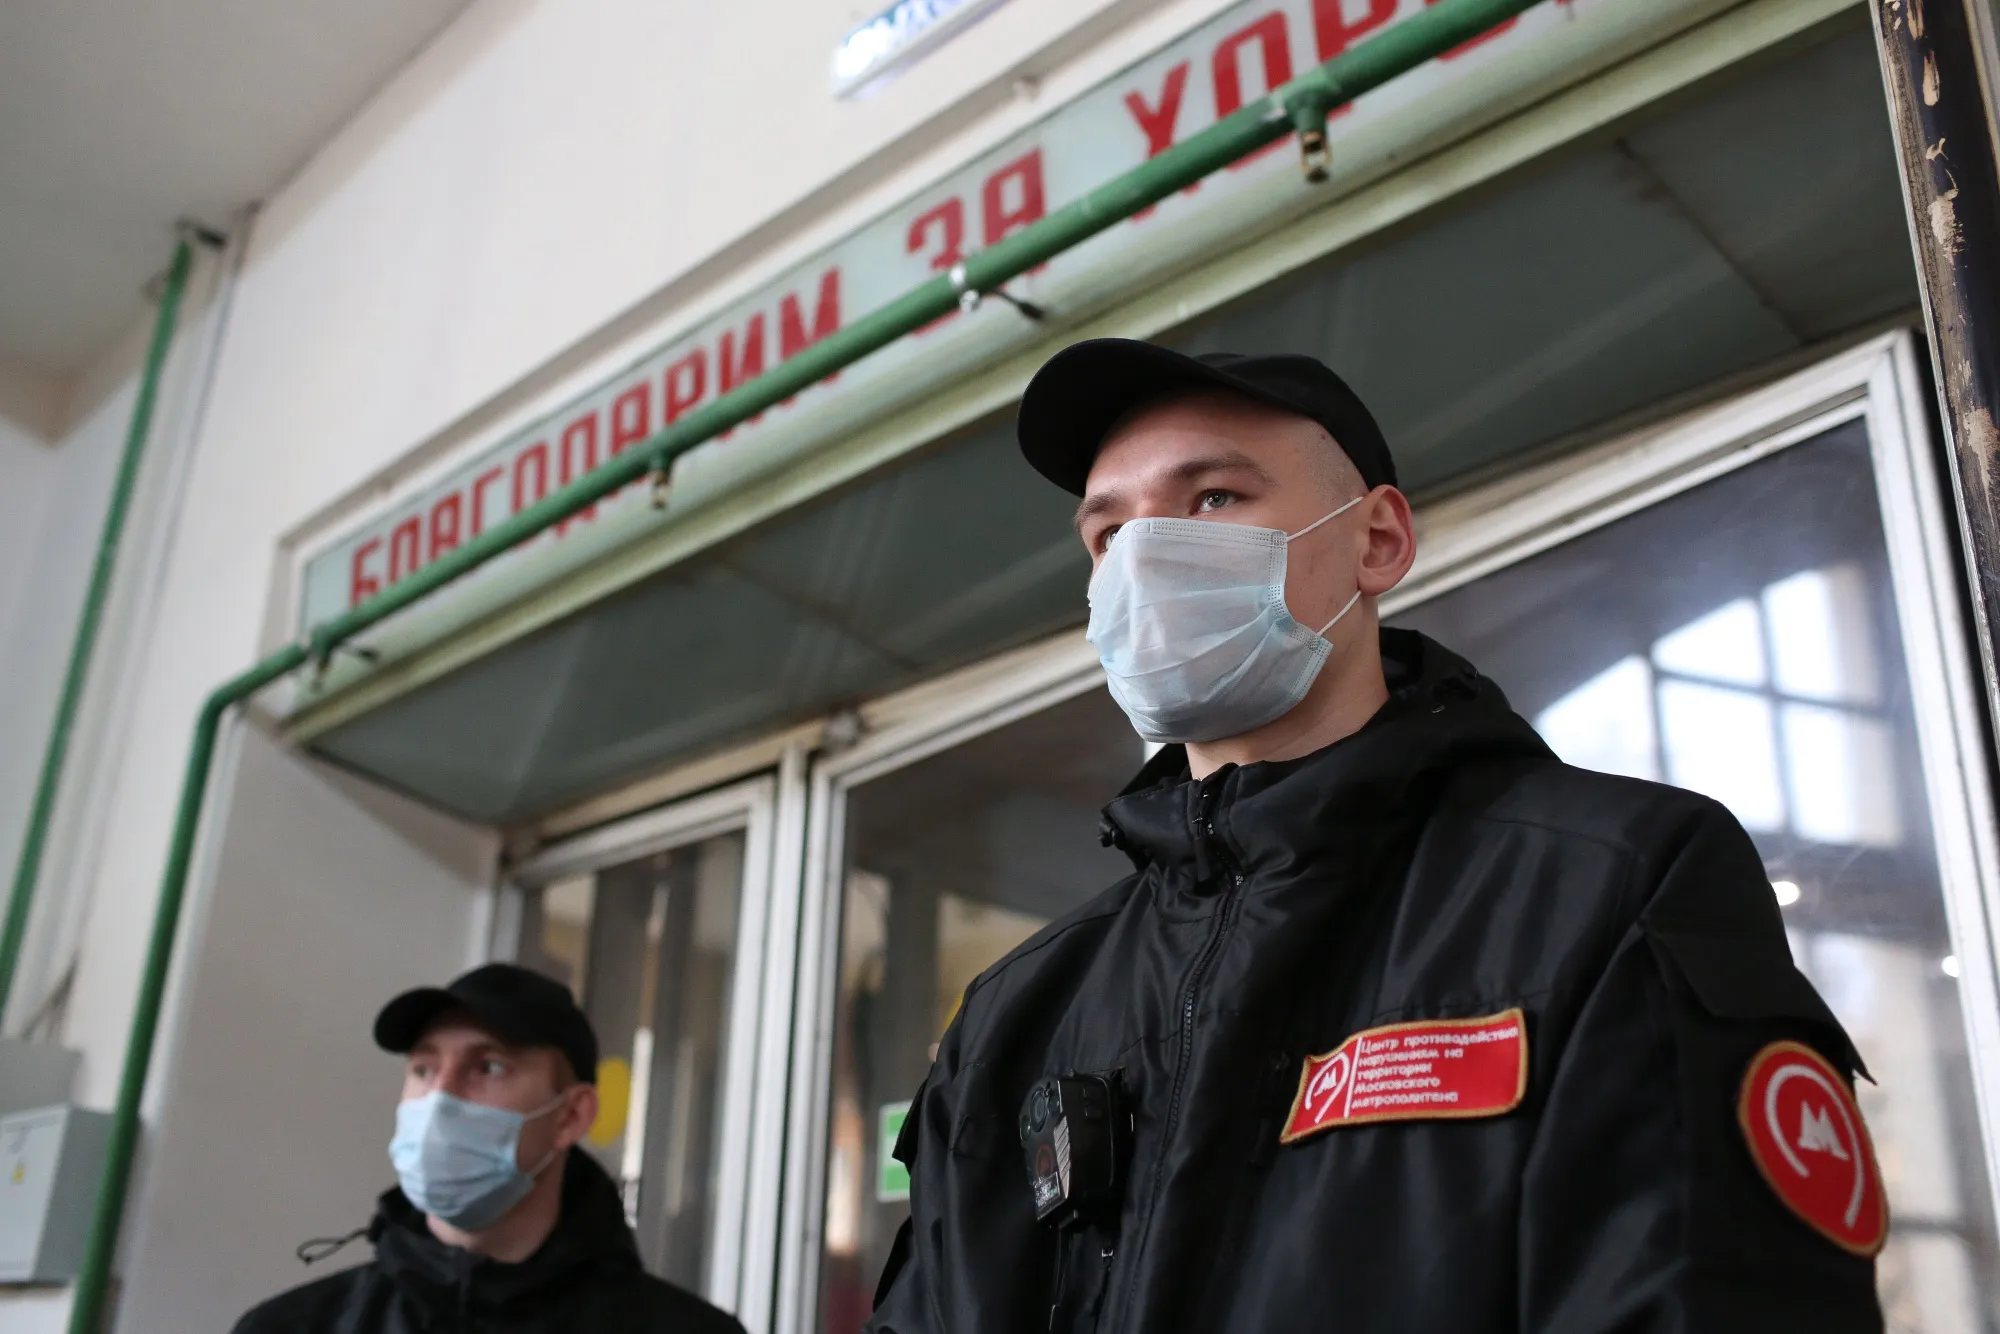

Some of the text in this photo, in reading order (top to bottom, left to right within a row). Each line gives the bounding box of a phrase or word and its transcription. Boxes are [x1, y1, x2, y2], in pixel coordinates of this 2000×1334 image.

[906, 147, 1054, 337] ЗА
[1361, 1026, 1519, 1054] Центр противодействия
[1358, 1048, 1464, 1067] нарушениям на
[1357, 1063, 1432, 1081] территории
[1353, 1077, 1441, 1094] Московского
[1351, 1091, 1459, 1109] метрополитена
